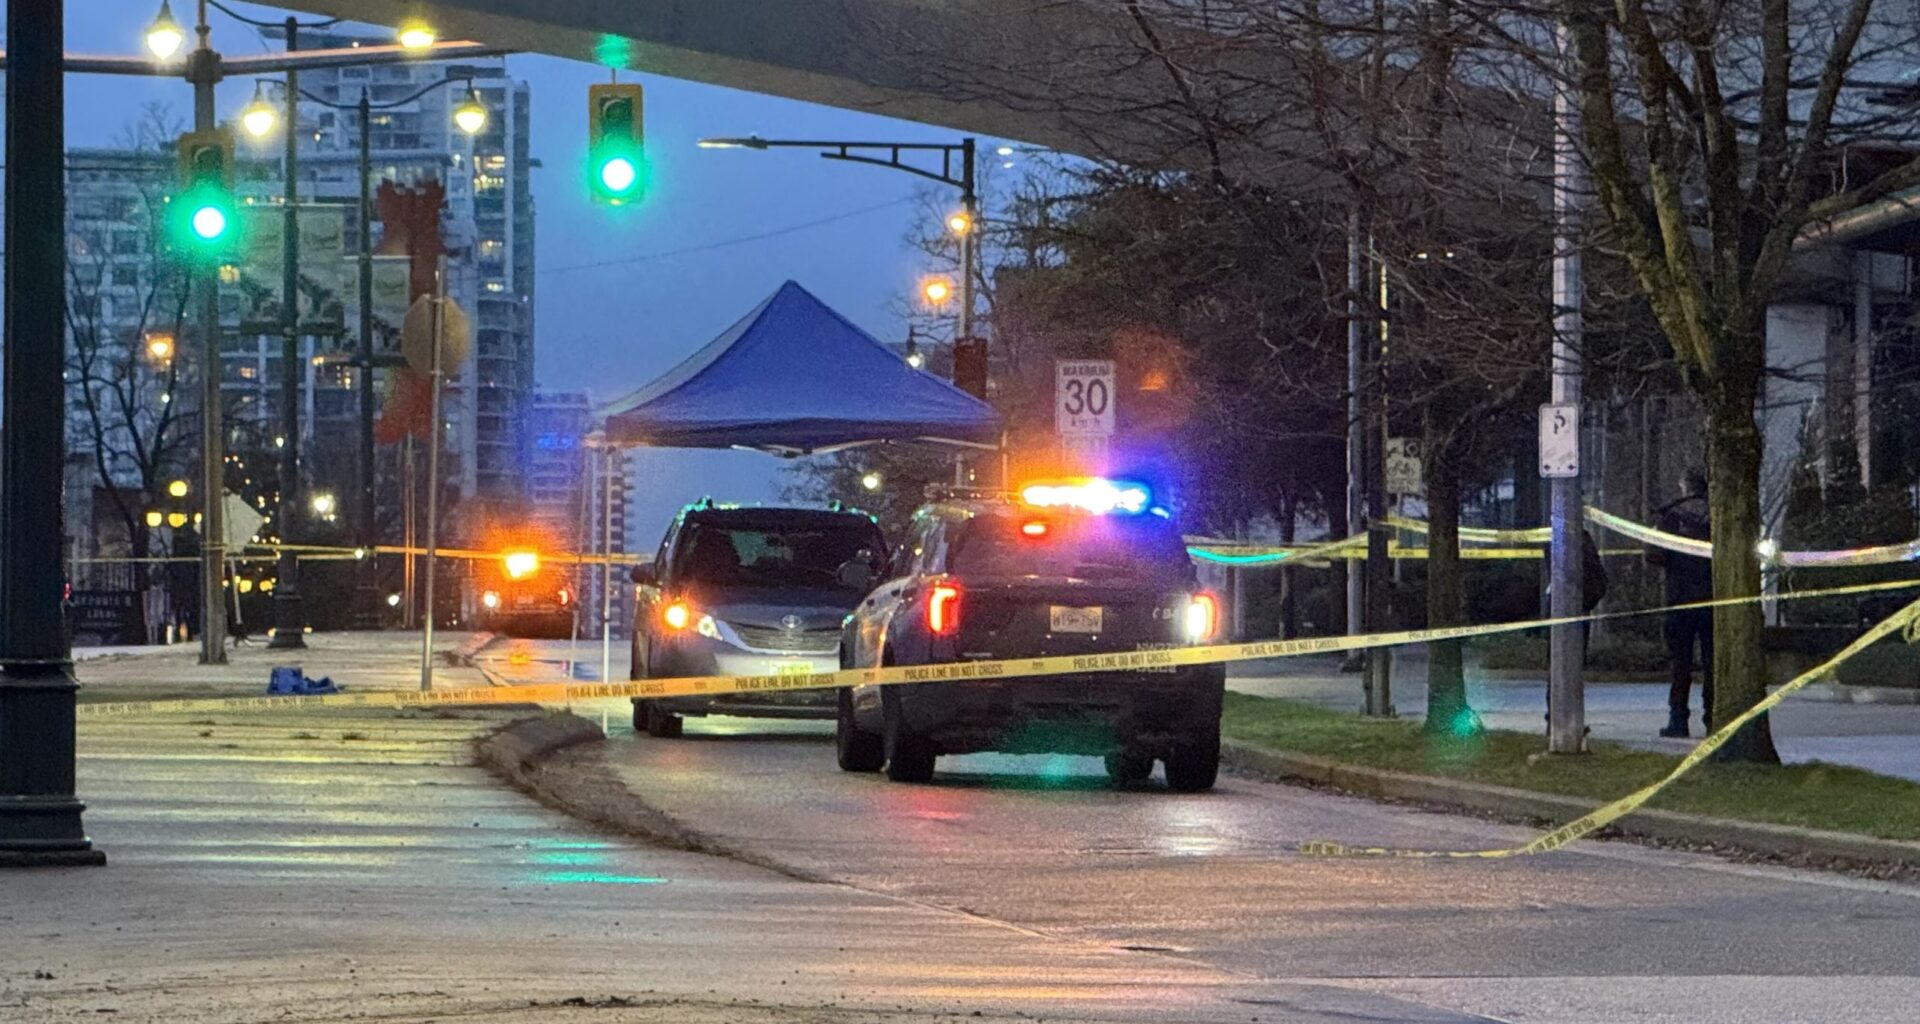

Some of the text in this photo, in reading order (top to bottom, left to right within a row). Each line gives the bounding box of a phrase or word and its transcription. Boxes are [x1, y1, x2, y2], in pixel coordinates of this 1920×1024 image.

[1065, 378, 1107, 416] 30
[1073, 652, 1172, 669] POLICE LINE DO NOT CROSS
[904, 668, 929, 679] POLICE
[932, 667, 946, 678] LINE
[950, 666, 960, 677] DO
[962, 664, 976, 676] NOT
[624, 683, 638, 695] NOT
[735, 678, 760, 689] POLICE
[782, 676, 791, 687] DO
[793, 674, 807, 686] NOT
